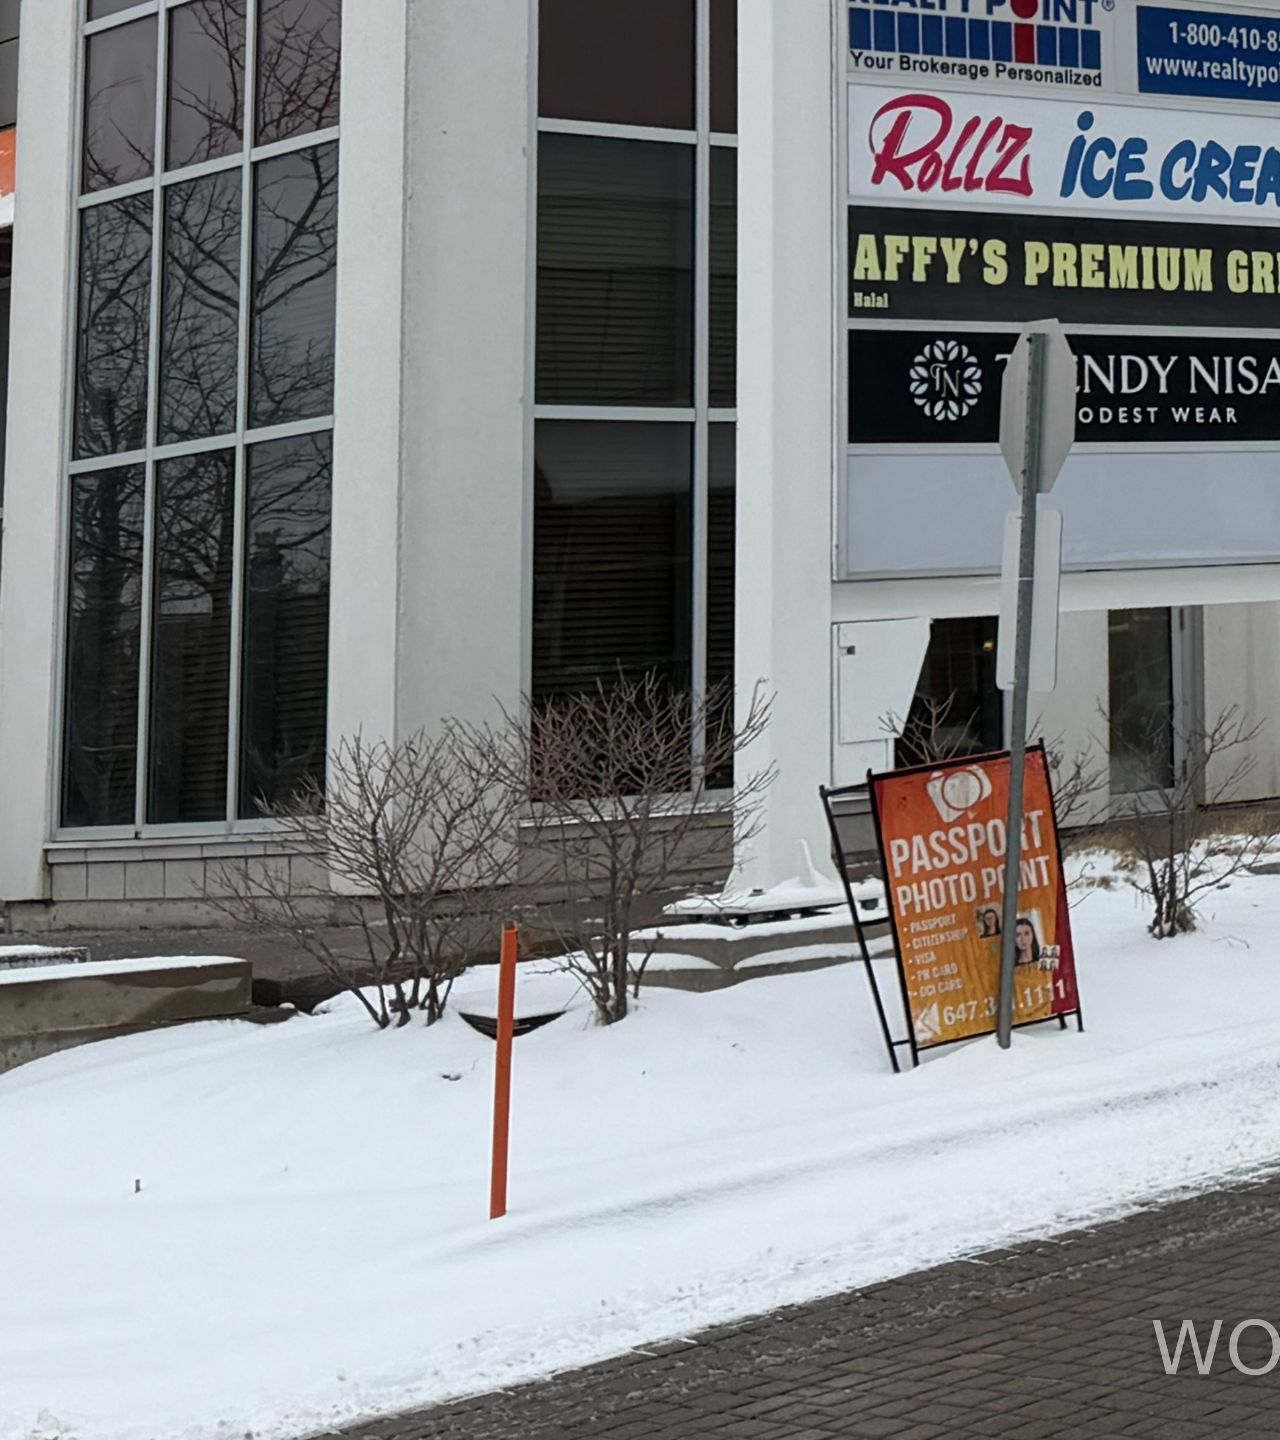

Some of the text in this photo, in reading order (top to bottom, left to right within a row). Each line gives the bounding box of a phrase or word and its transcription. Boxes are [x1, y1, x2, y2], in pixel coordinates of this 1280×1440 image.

[850, 50, 1103, 88] Your Brokerage Personalized
[853, 233, 1009, 286] AFFY'S
[1024, 240, 1213, 292] PREMIUM
[853, 292, 889, 309] Halal
[1078, 406, 1238, 424] ODEST WEAR
[896, 869, 977, 918] PHOTO
